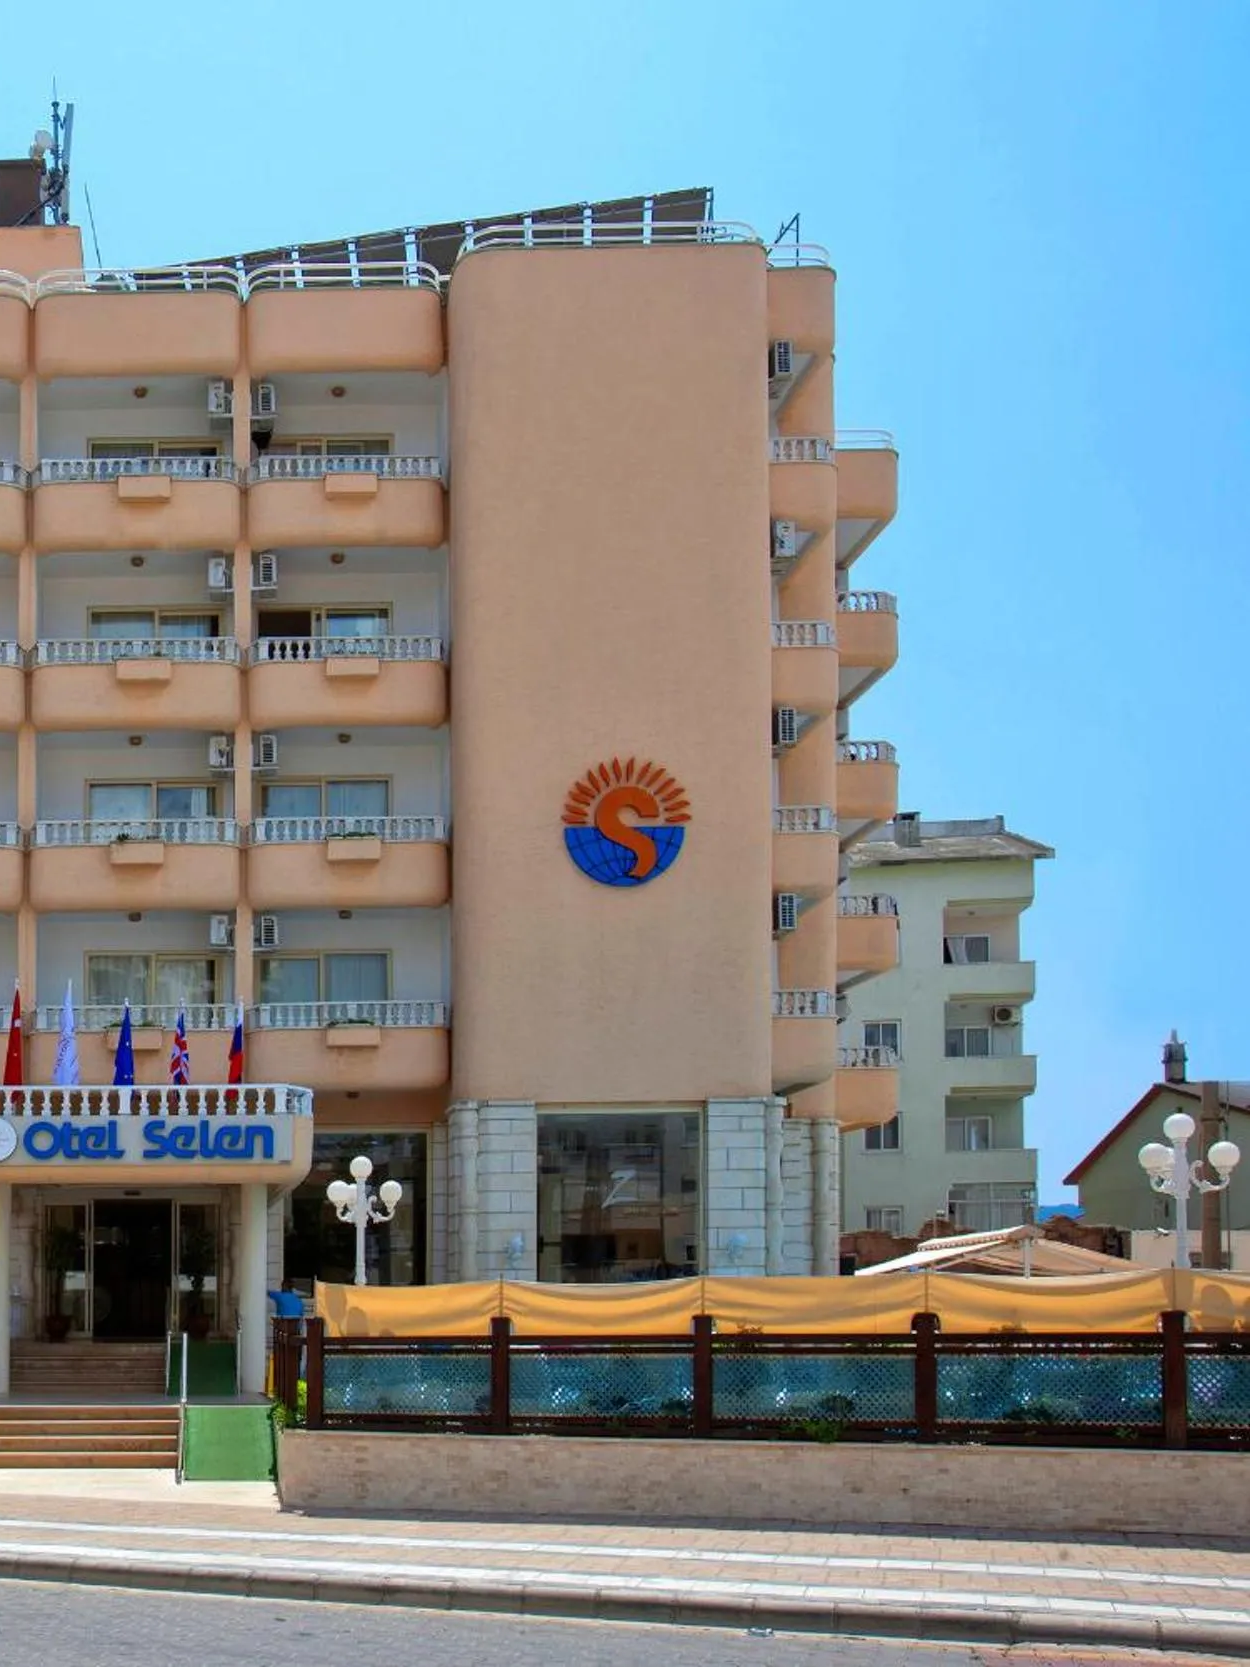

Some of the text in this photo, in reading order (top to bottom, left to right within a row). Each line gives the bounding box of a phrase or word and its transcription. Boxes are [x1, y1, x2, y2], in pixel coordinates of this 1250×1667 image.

[595, 786, 659, 879] S
[23, 1120, 274, 1159] Otel Selen
